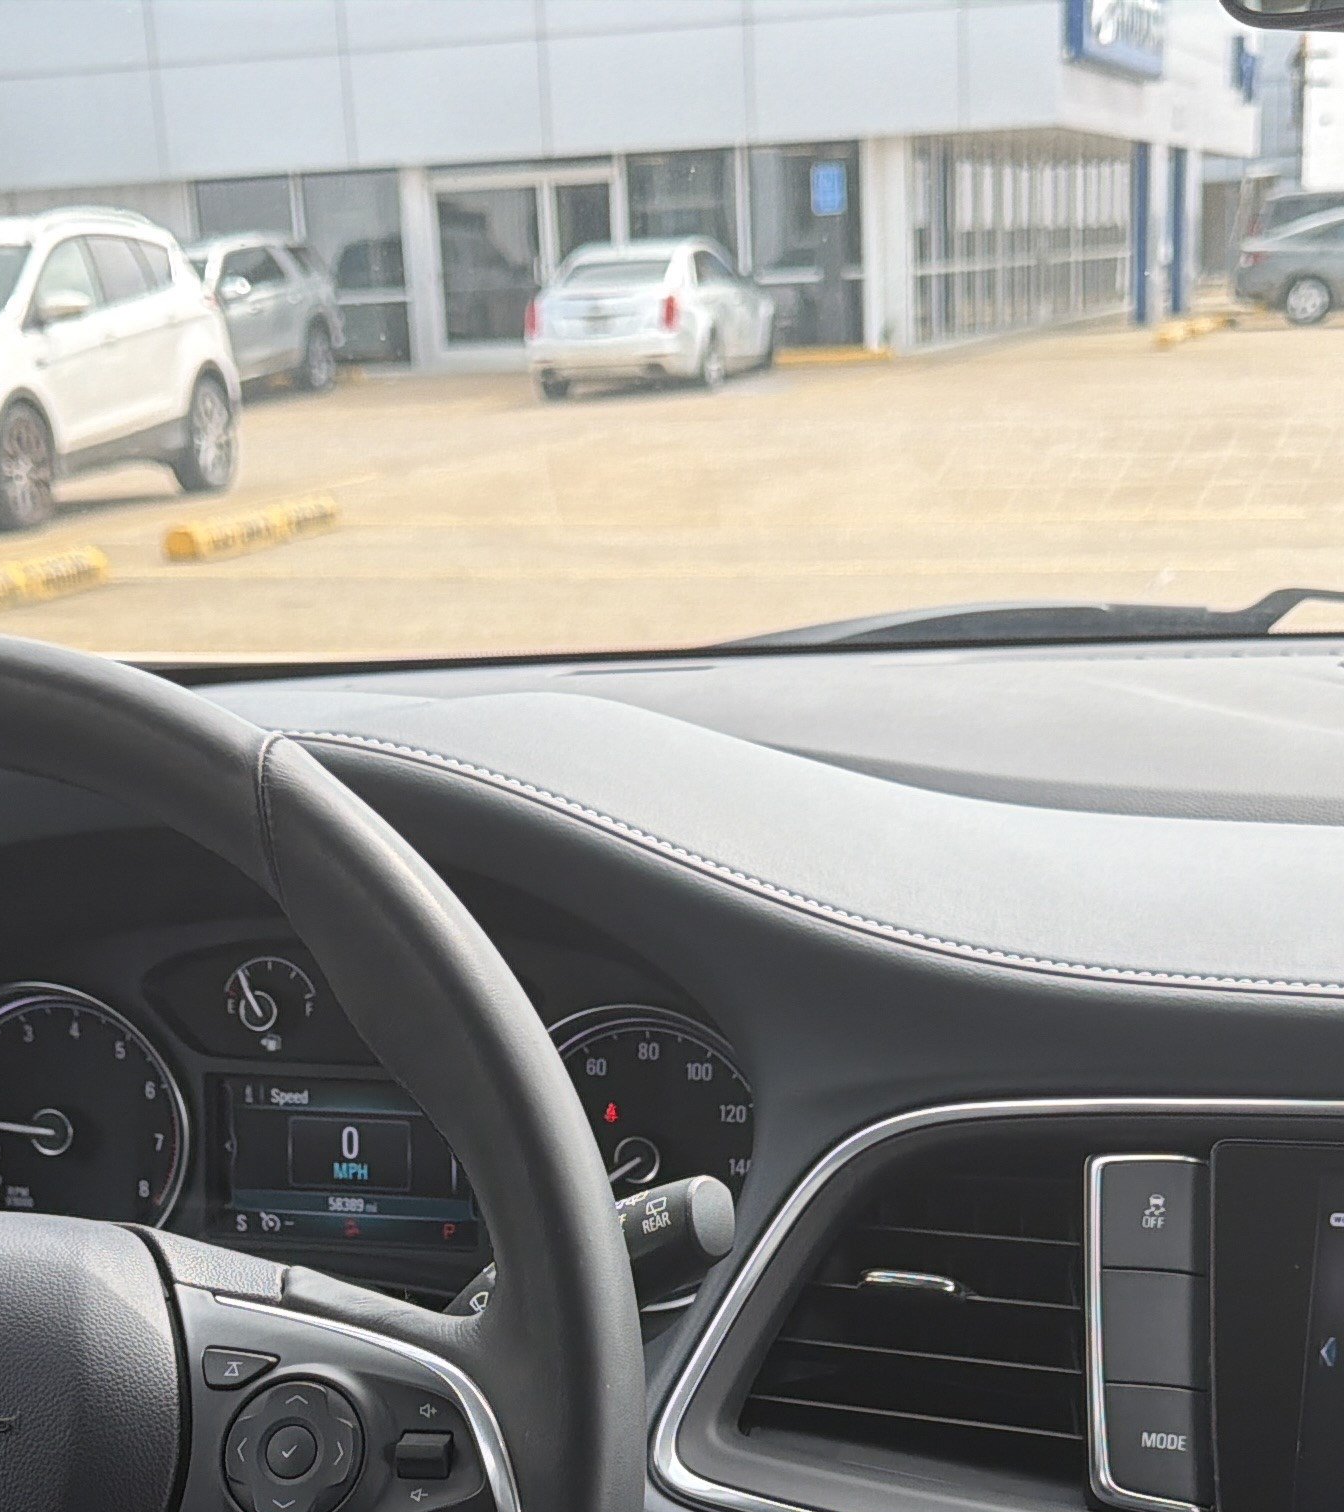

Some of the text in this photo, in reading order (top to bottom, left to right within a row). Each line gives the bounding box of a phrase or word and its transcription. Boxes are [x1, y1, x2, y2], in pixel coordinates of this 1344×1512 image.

[227, 998, 236, 1014] E
[305, 1001, 314, 1017] F
[23, 1023, 35, 1043] 3
[68, 1021, 80, 1039] 4
[114, 1040, 126, 1060] 5
[638, 1042, 660, 1060] 80
[586, 1058, 607, 1076] 60
[686, 1062, 713, 1081] 100
[144, 1080, 156, 1099] 6
[270, 1088, 309, 1106] Speed
[719, 1104, 746, 1123] 120
[154, 1133, 164, 1151] 7
[341, 1126, 359, 1160] 0
[333, 1163, 369, 1180] MPH
[138, 1179, 150, 1198] 8
[236, 1213, 248, 1232] S
[443, 1223, 456, 1239] P
[641, 1211, 672, 1235] REAR
[1141, 1215, 1166, 1229] OFF
[1141, 1431, 1187, 1451] MODE
